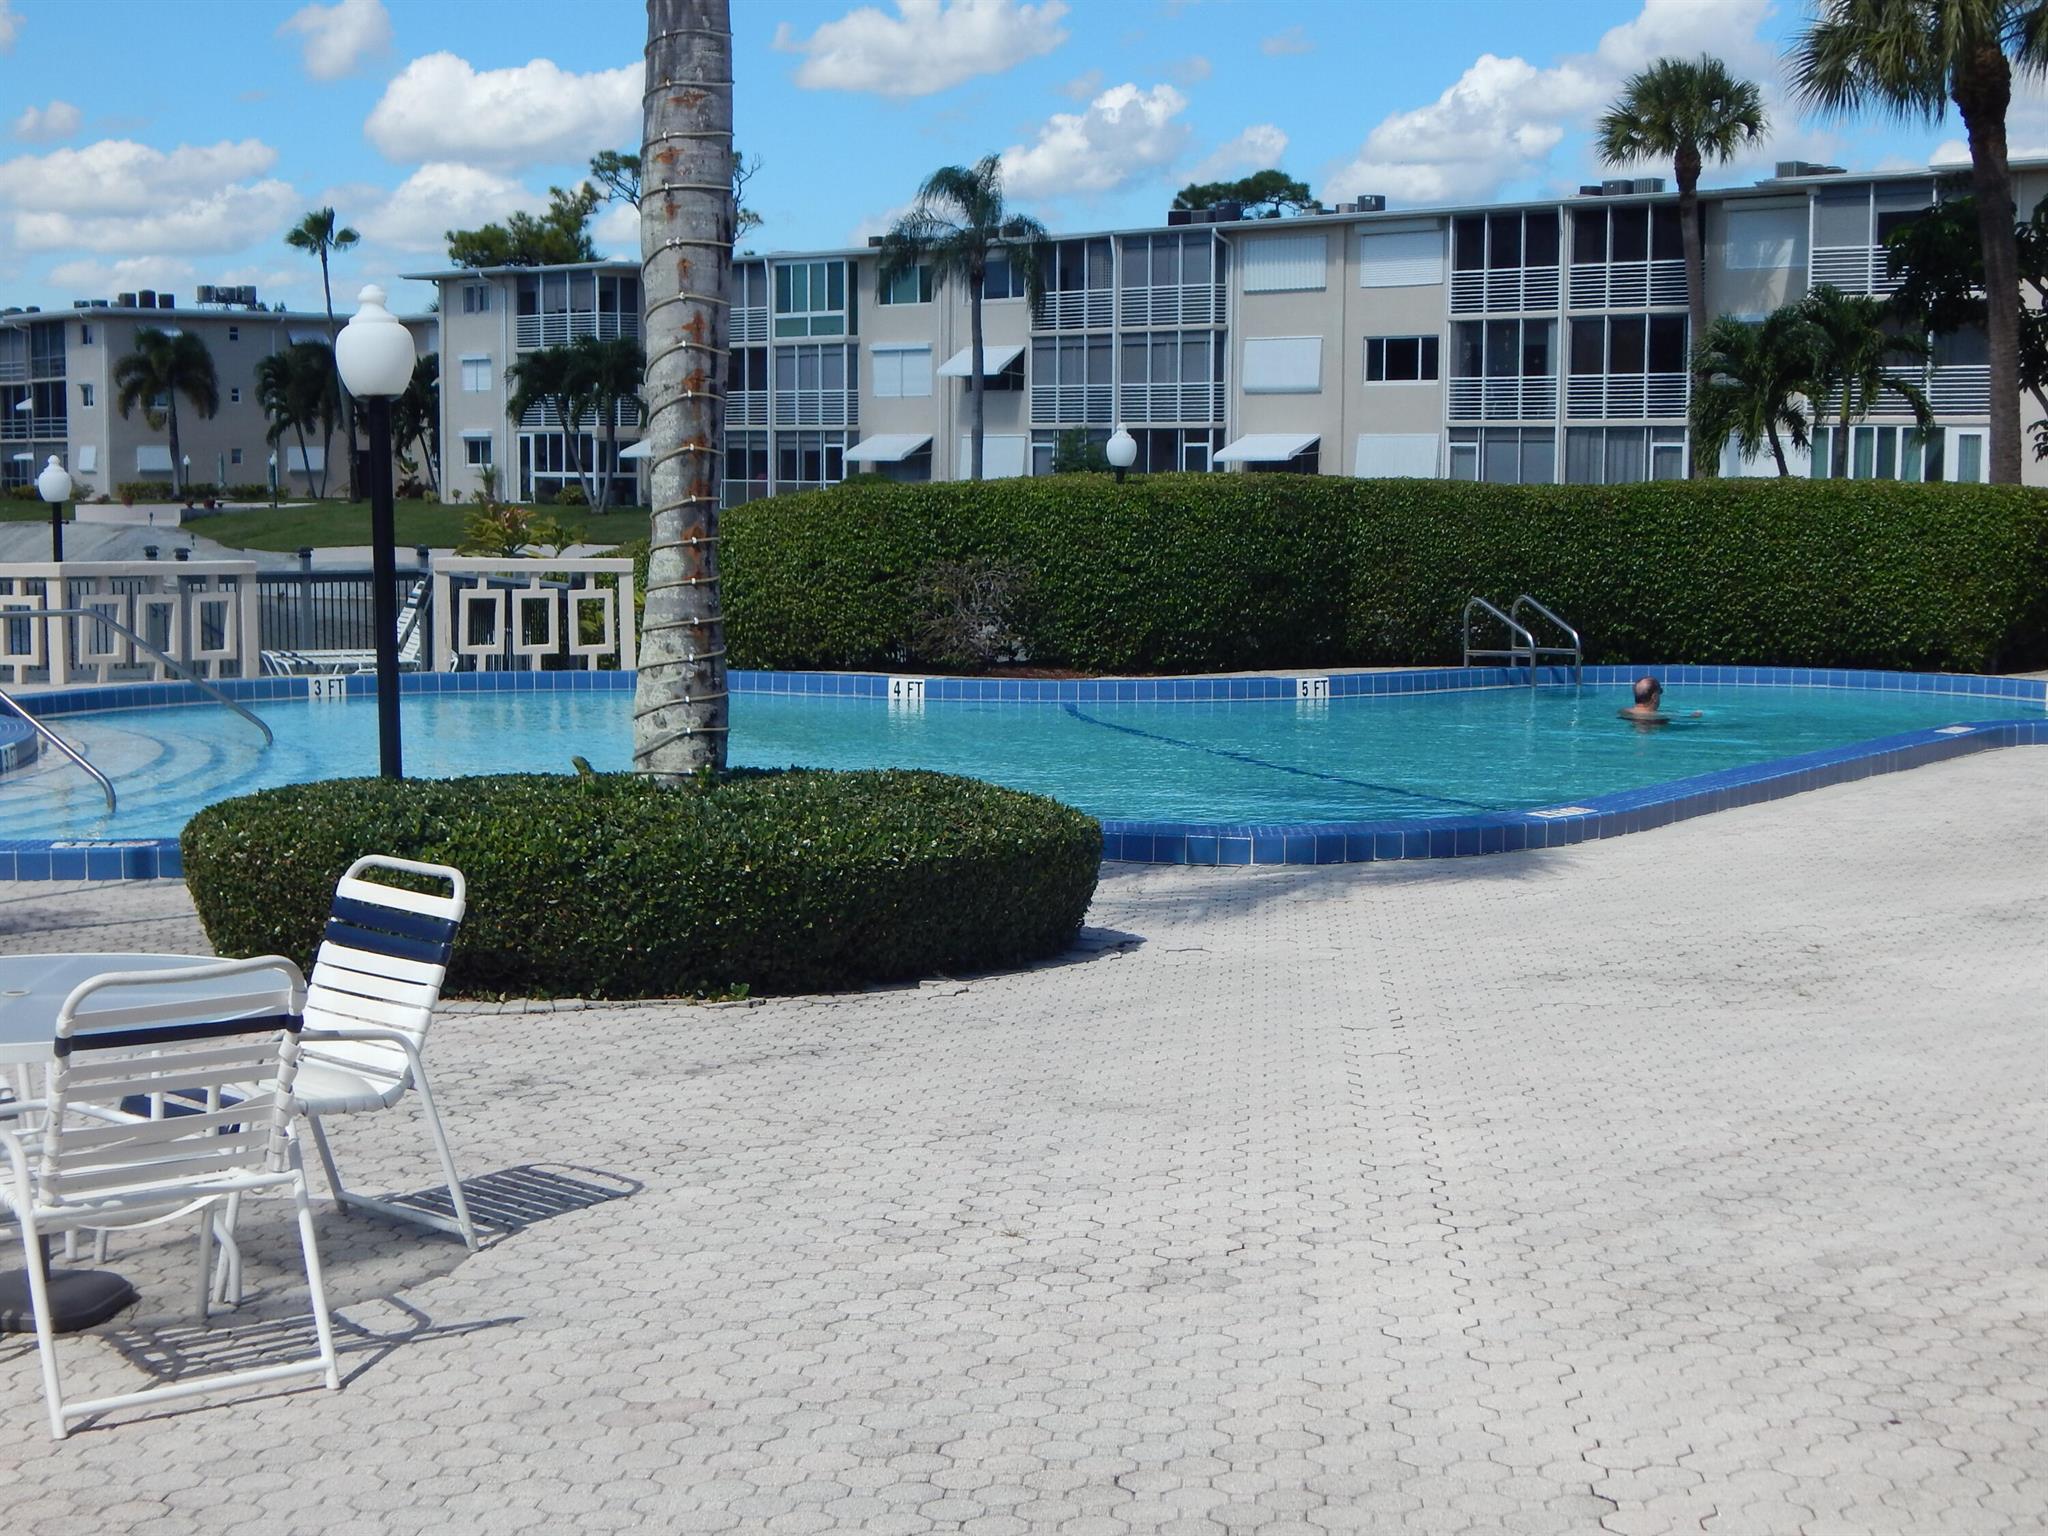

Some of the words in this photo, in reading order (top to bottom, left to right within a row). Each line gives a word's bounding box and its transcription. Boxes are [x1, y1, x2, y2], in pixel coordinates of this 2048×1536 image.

[314, 680, 322, 696] 3
[328, 679, 344, 696] FT
[894, 681, 901, 697] 4
[908, 682, 923, 698] FT
[1302, 681, 1308, 697] 5
[1314, 680, 1328, 697] FT
